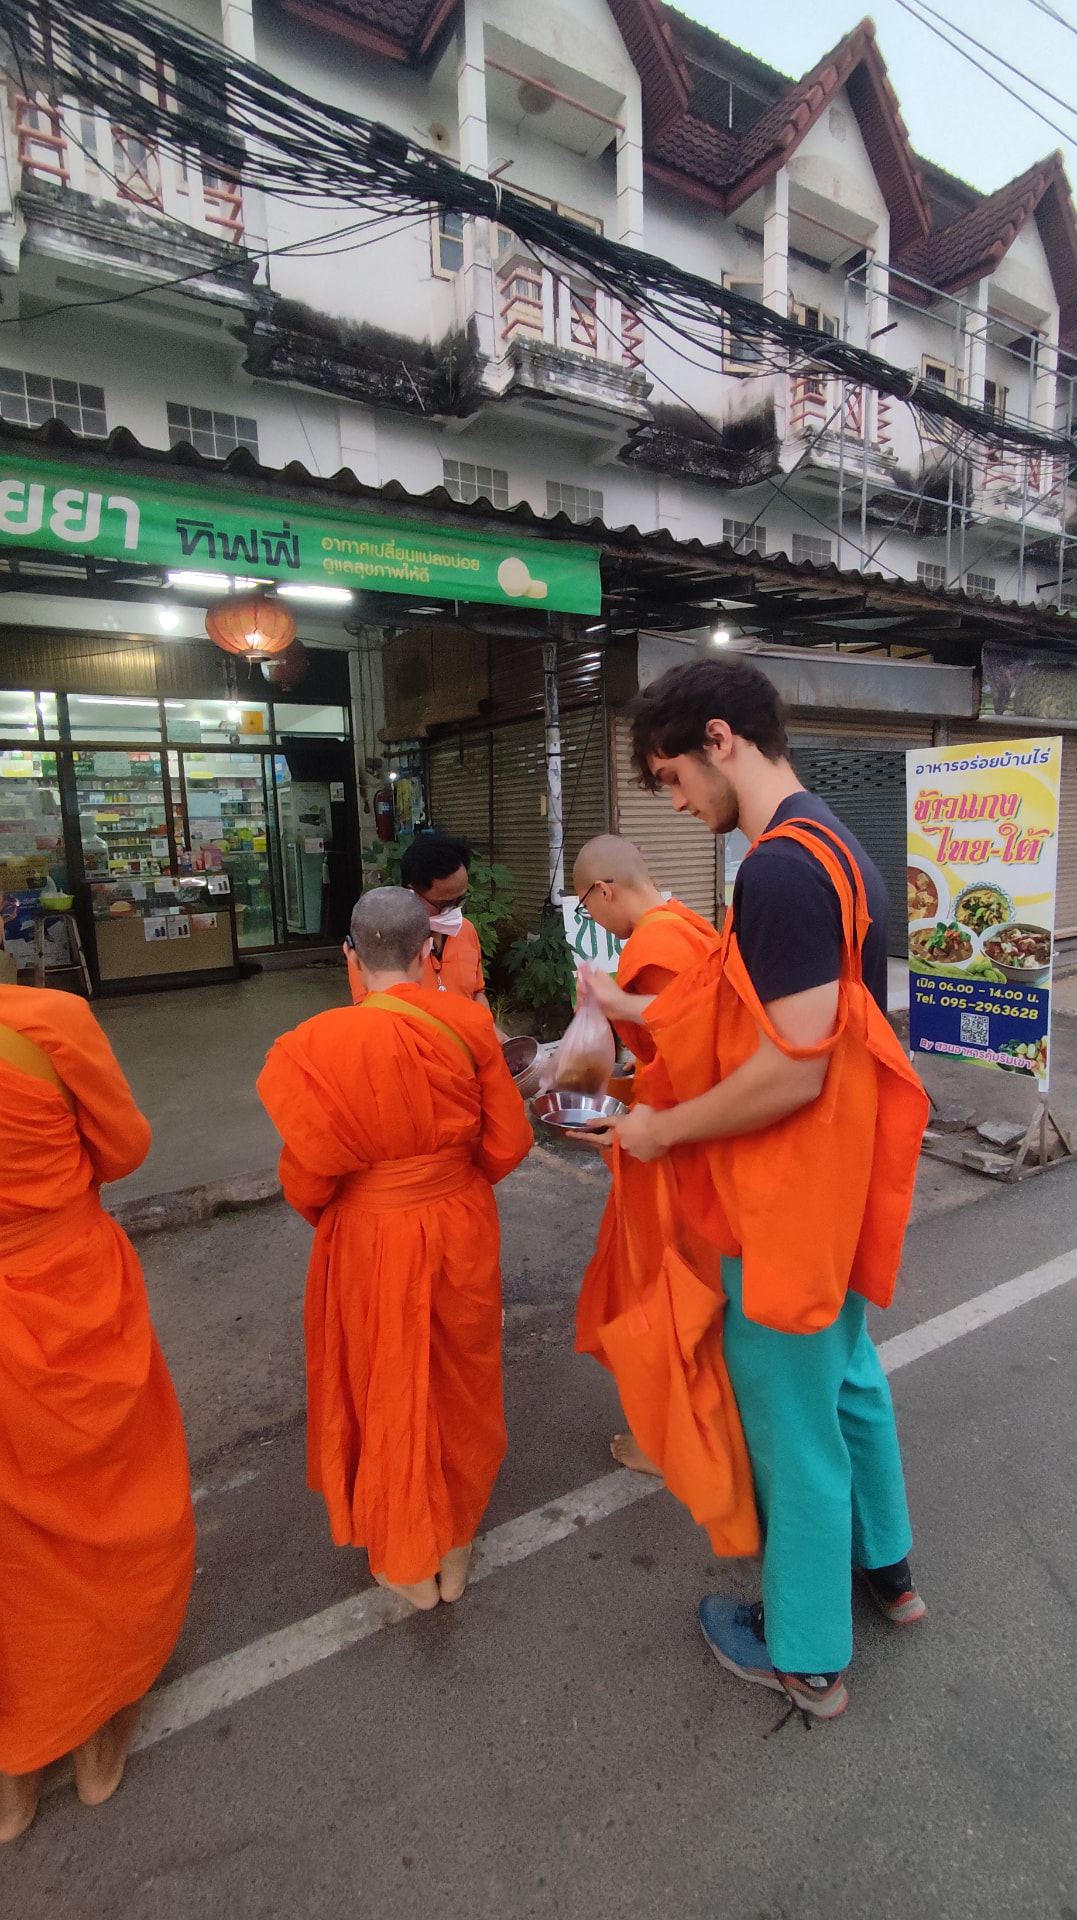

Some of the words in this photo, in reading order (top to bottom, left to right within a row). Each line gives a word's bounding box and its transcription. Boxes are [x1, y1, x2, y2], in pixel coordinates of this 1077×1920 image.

[175, 518, 300, 569] ทิฟฟี่
[321, 537, 480, 571] อากาศเปลี่ยนแปลงบ่อย
[323, 557, 430, 583] ดูแลสุขภาพให้ดี
[915, 748, 1051, 775] อาหารอร่อยบ้านไร่
[914, 790, 1019, 822] ข้าวแกง
[922, 822, 1051, 863] ไทย-ใต้
[916, 978, 935, 989] เปิด
[938, 982, 974, 994] 06.00
[989, 988, 1024, 1001] 14.00
[1027, 993, 1039, 1003] น.
[915, 992, 936, 1005] Tel.
[940, 996, 1039, 1020] 095-2963628
[919, 1038, 934, 1051] By
